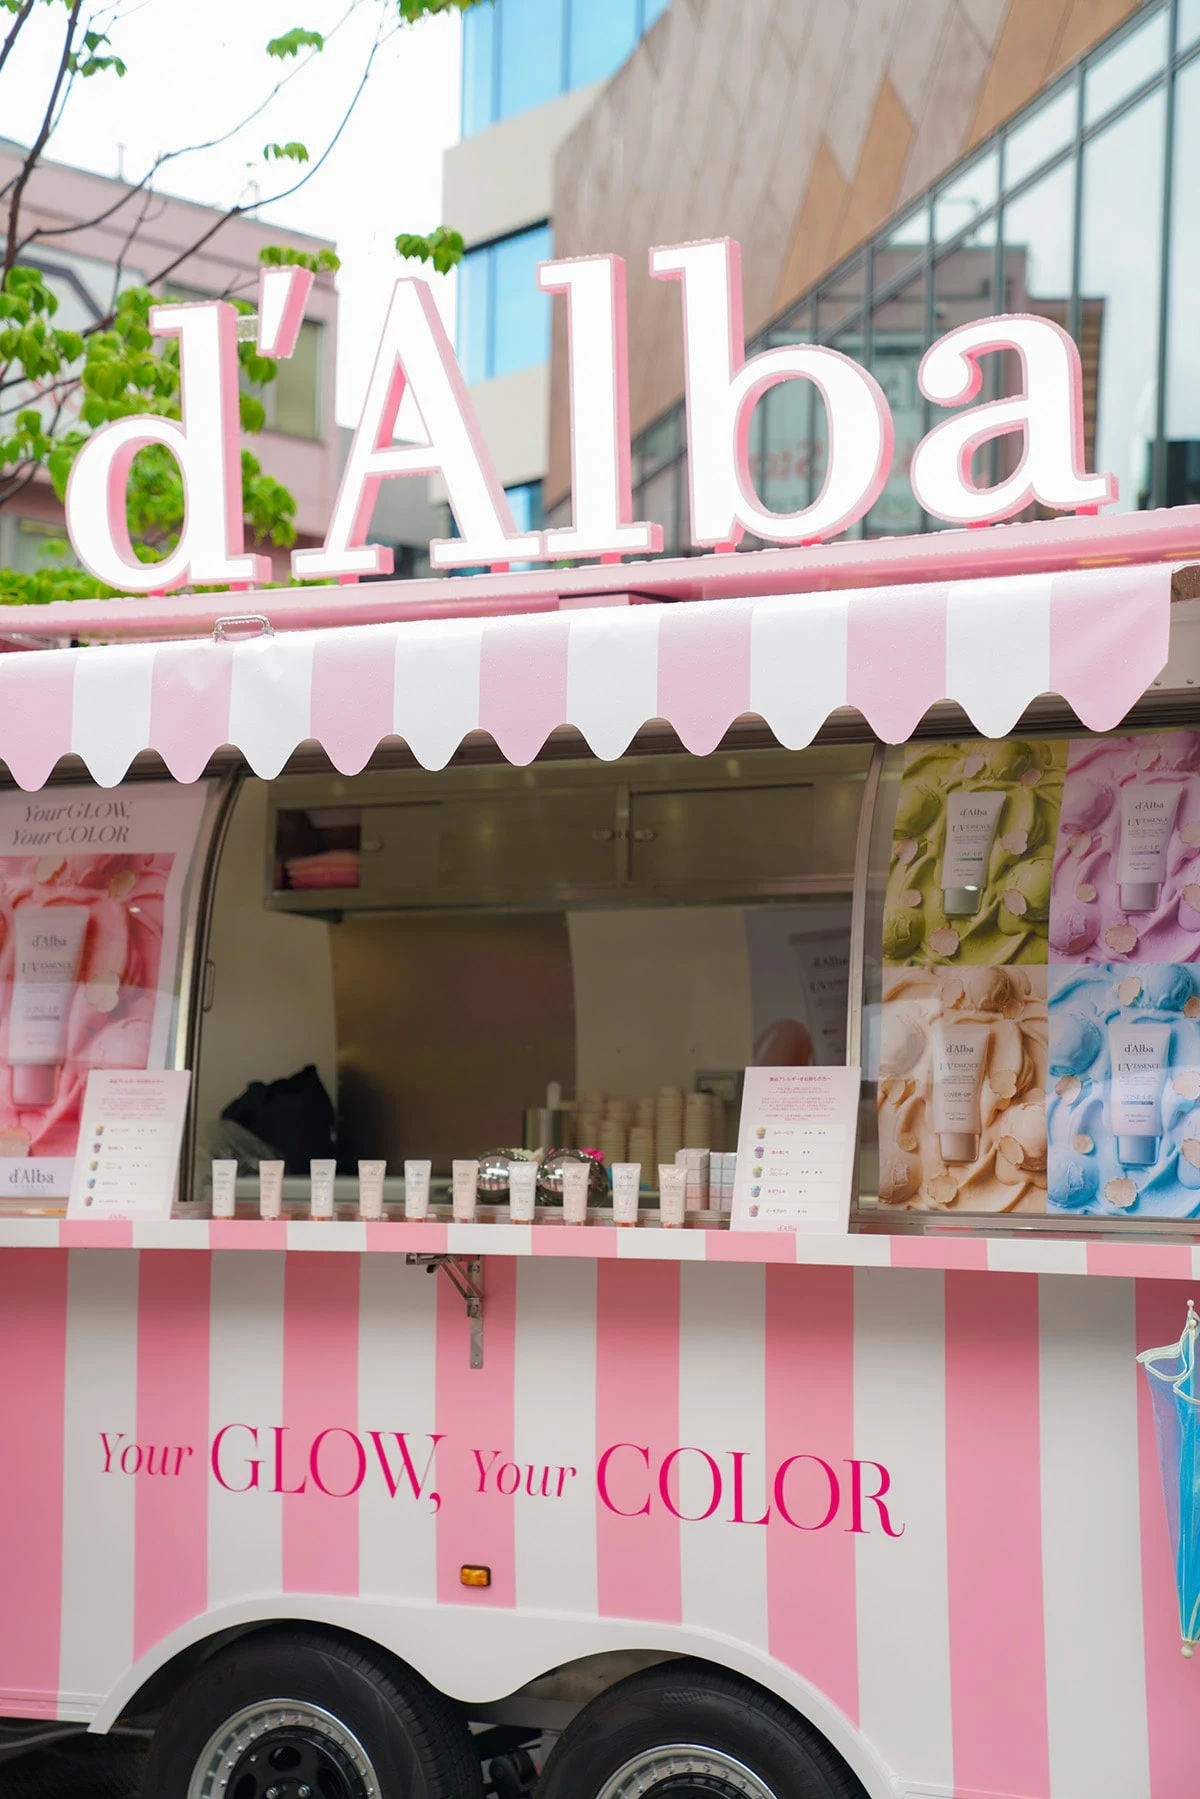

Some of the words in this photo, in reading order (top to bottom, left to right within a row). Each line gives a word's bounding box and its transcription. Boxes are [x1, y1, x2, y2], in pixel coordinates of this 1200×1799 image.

[65, 237, 1118, 593] d'Alba
[1135, 800, 1164, 810] d'Alba
[946, 1043, 974, 1054] d'Alba
[1124, 1043, 1154, 1054] d'Alba
[9, 1168, 54, 1184] d'Alba
[97, 1431, 194, 1477] Your
[211, 1423, 447, 1515] GLOW,
[471, 1448, 577, 1498] Your
[597, 1443, 906, 1538] COLOR
